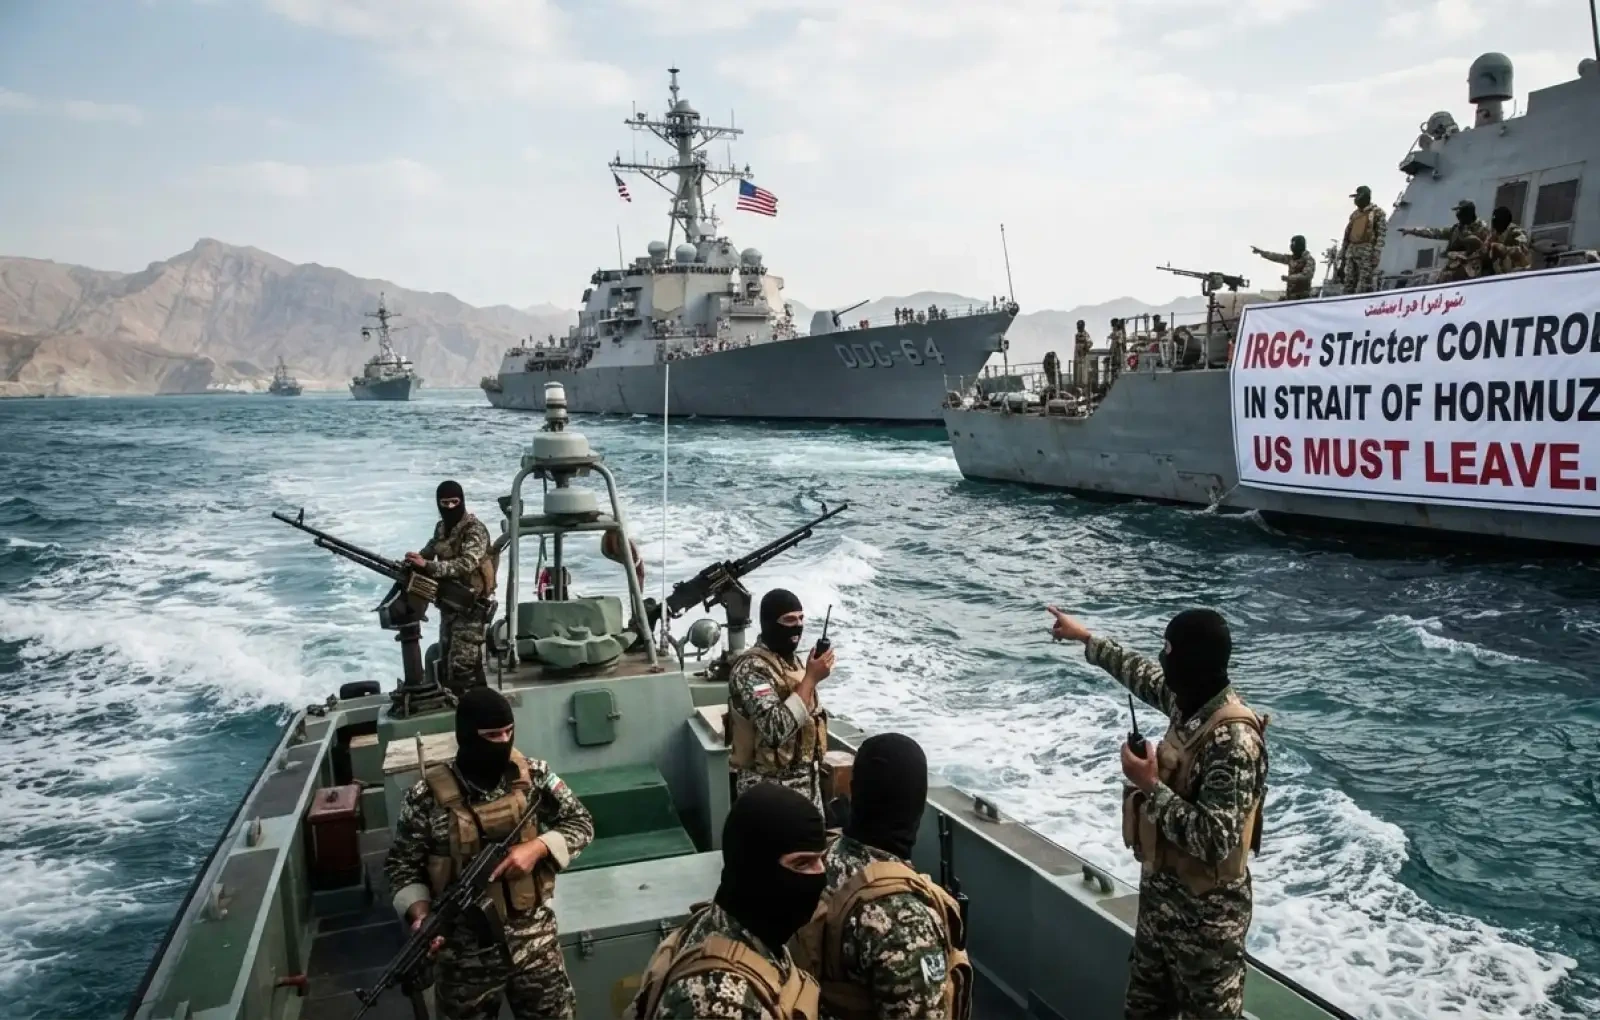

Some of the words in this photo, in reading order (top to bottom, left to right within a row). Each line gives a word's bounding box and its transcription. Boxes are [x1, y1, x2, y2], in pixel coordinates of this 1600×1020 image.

[1243, 329, 1314, 369] IRGC:
[1319, 328, 1429, 368] STricter
[1243, 385, 1266, 419] IN
[1274, 384, 1372, 421] STRAIT
[1381, 383, 1423, 422] OF
[1434, 377, 1600, 422] HORMUZ
[1253, 435, 1293, 474] US
[1303, 437, 1410, 481] MUST
[1424, 440, 1597, 492] LEAVE.
